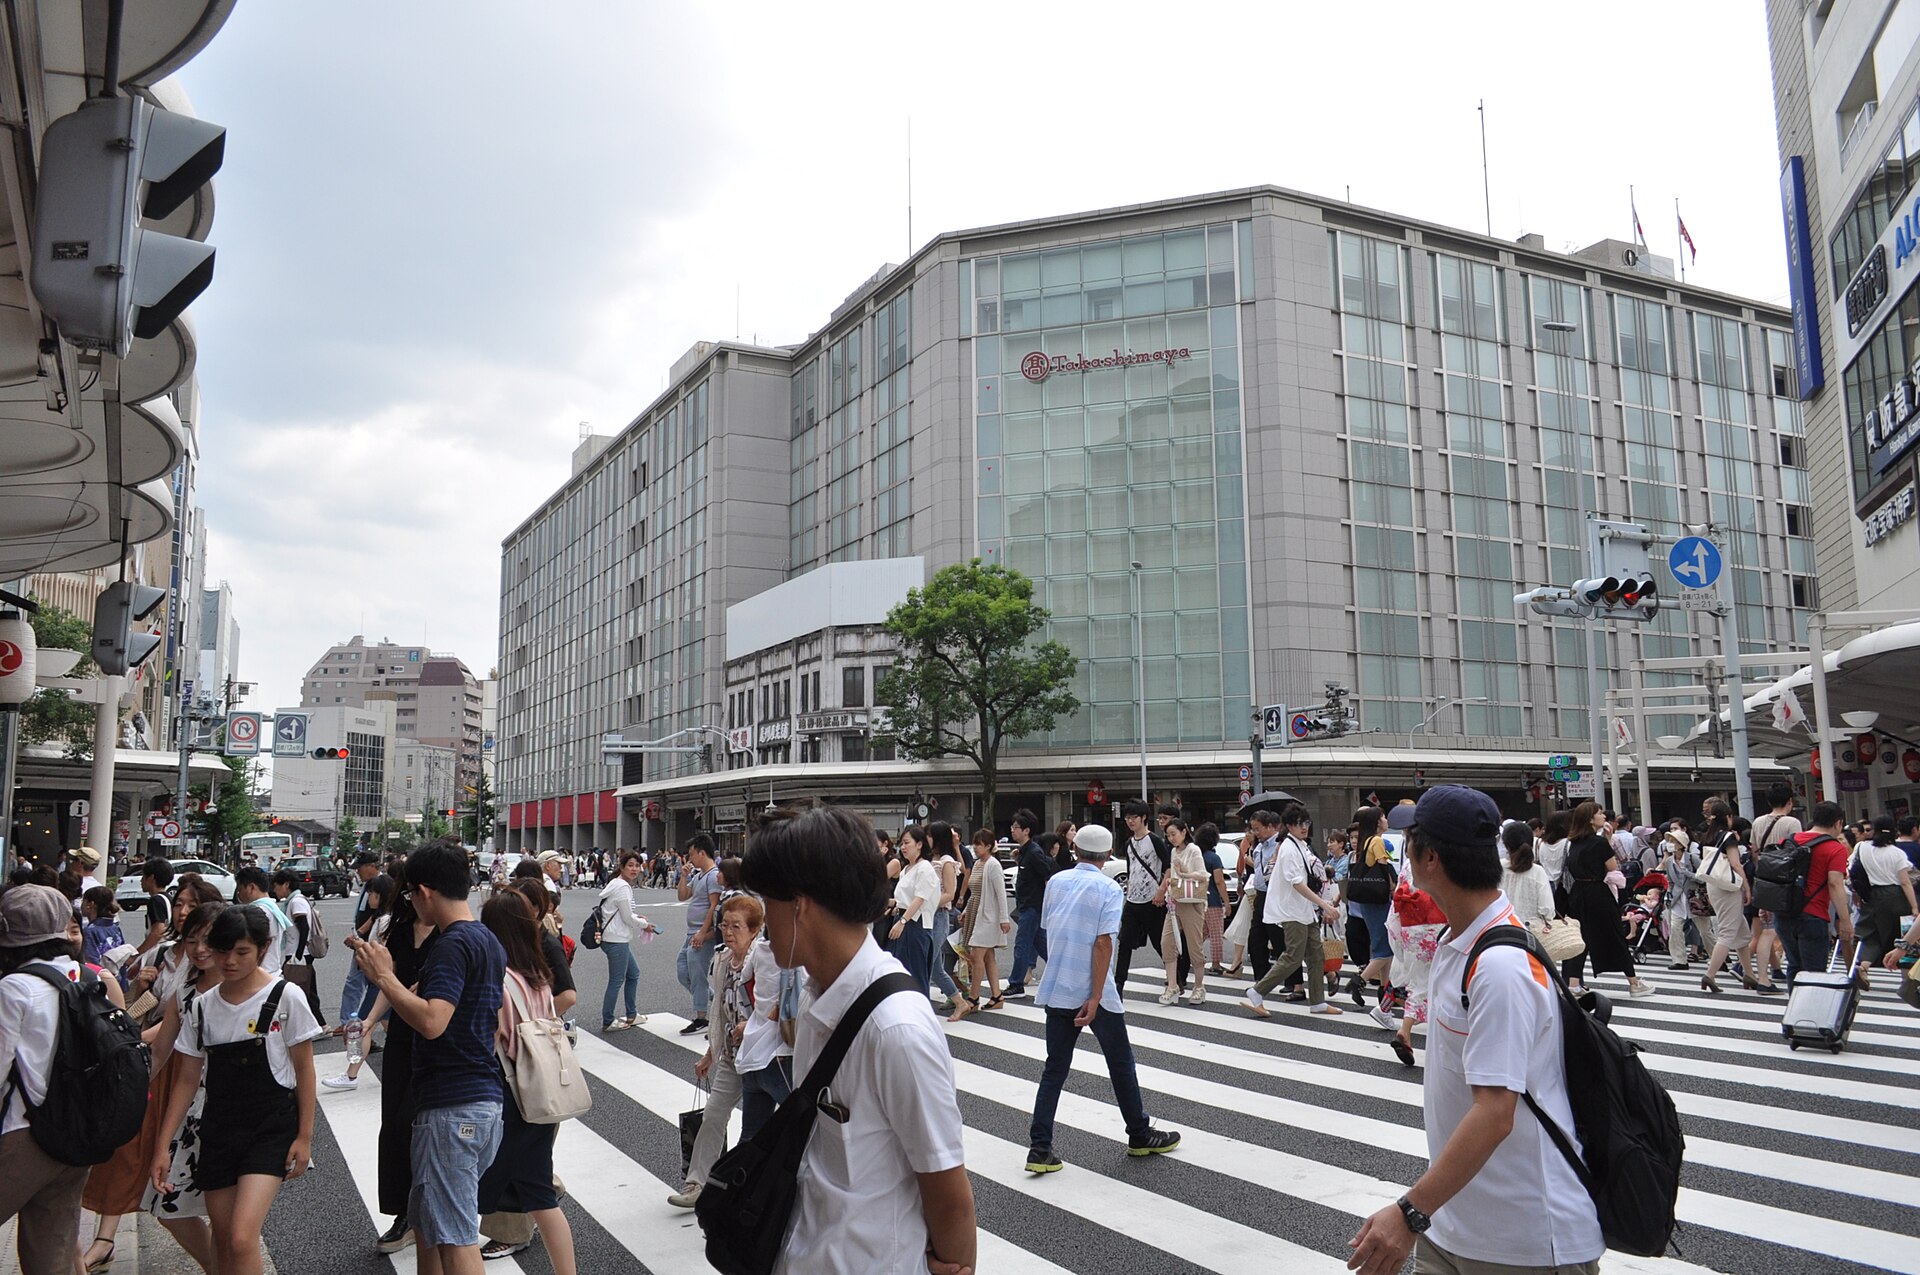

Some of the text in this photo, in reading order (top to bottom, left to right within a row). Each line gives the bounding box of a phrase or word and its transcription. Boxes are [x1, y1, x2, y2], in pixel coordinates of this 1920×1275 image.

[1786, 183, 1798, 266] MIZUHO
[1052, 346, 1191, 372] Takashimaya
[461, 1127, 473, 1135] Lee
